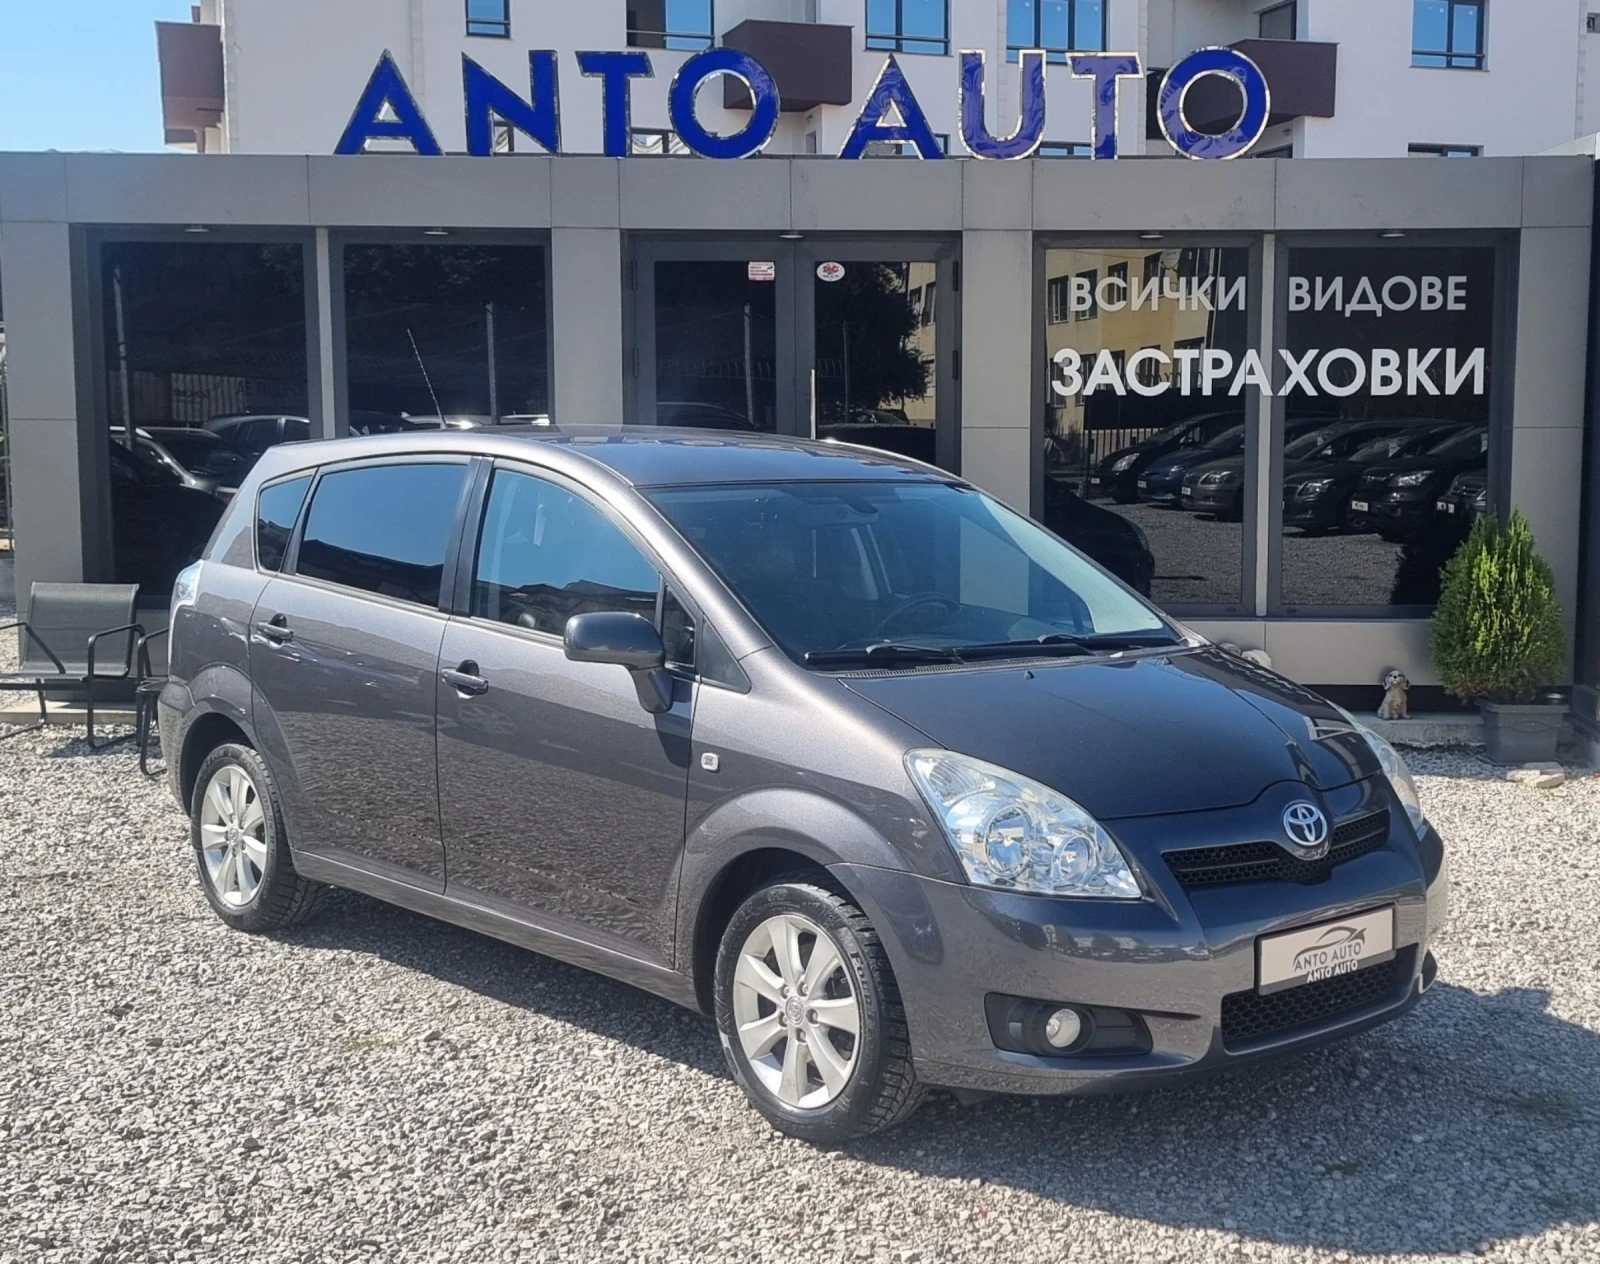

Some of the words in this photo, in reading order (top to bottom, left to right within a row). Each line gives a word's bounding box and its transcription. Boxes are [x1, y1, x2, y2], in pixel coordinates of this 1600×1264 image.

[333, 48, 780, 158] ANTO
[837, 46, 1271, 160] AUTO
[1069, 276, 1246, 311] ВСИЧКИ
[1288, 276, 1467, 317] ВИДОВЕ
[1051, 347, 1485, 396] ЗАСТРАХОВКИ
[1295, 951, 1328, 972] ANTO
[1332, 942, 1361, 961] AUTO
[1307, 967, 1332, 983] ANTO
[1334, 960, 1358, 975] AUTO
